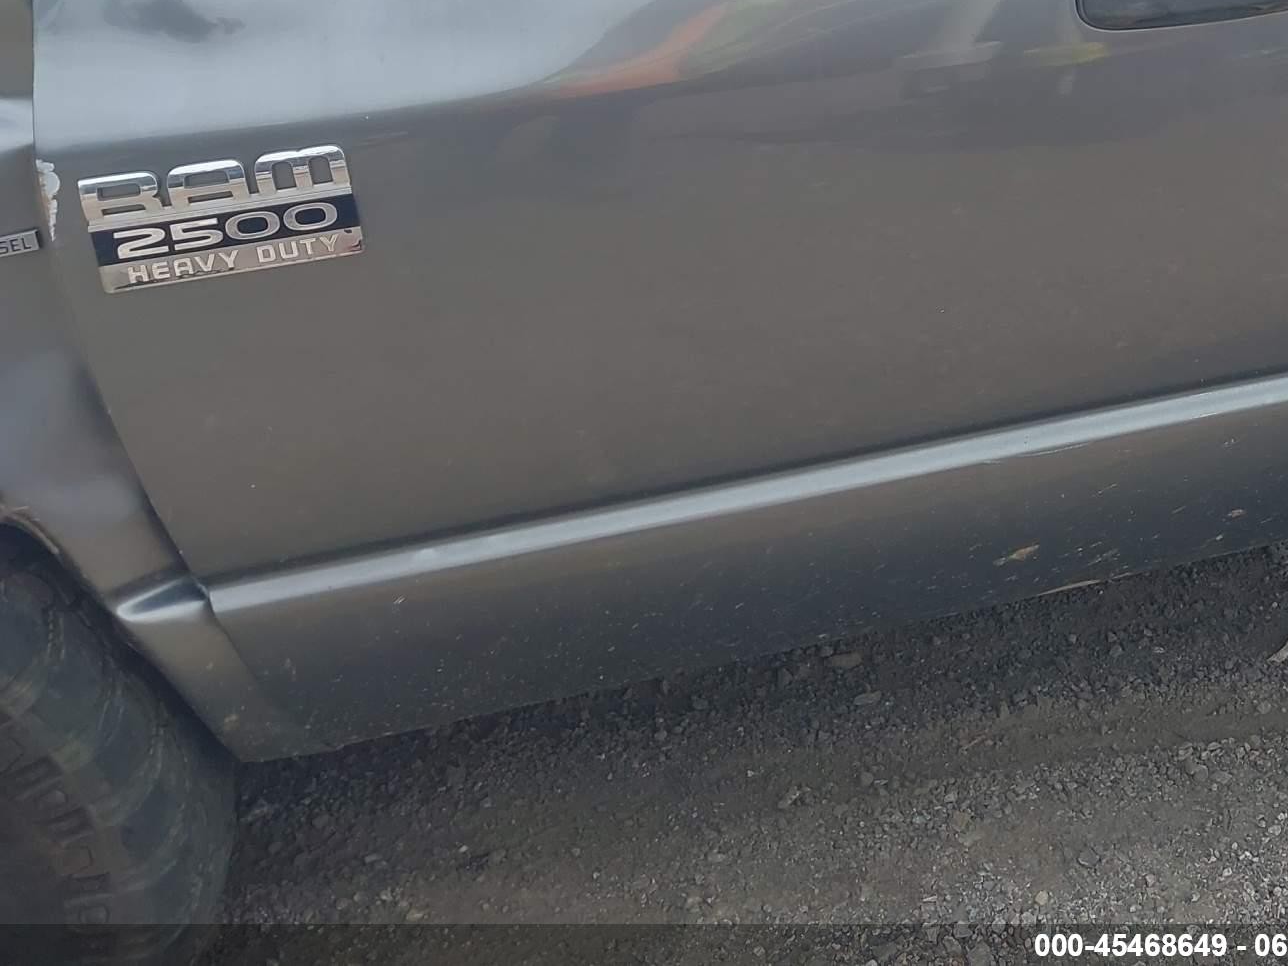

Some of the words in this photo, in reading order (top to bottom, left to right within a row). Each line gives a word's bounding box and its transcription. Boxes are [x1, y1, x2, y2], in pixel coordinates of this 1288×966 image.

[77, 144, 351, 223] RAM
[113, 202, 338, 260] 2500
[128, 250, 239, 284] HEAVY
[256, 235, 339, 264] DUTY
